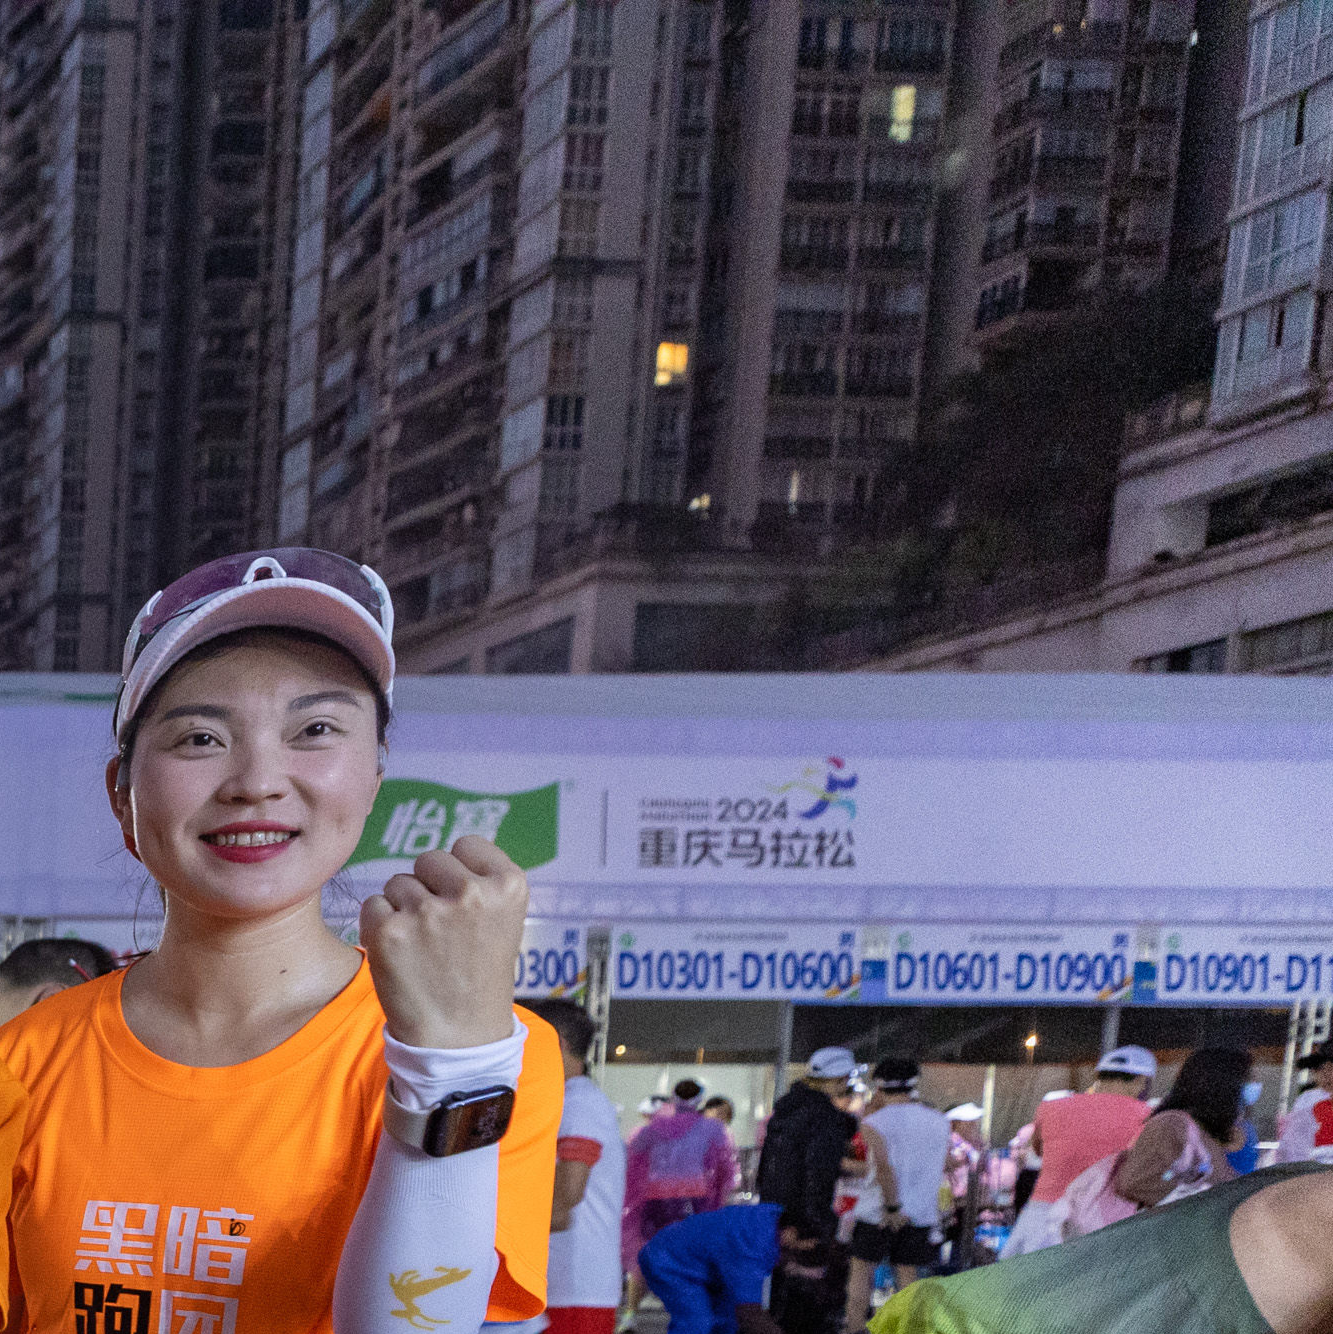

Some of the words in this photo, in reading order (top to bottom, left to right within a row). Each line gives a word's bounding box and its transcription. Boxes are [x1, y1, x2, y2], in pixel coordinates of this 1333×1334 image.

[717, 799, 789, 823] 2024
[638, 828, 857, 869] 重庆马拉松
[619, 951, 855, 990] D10301-D10600
[896, 952, 1127, 991] D10601-D10900
[74, 1200, 254, 1286] 黑暗
